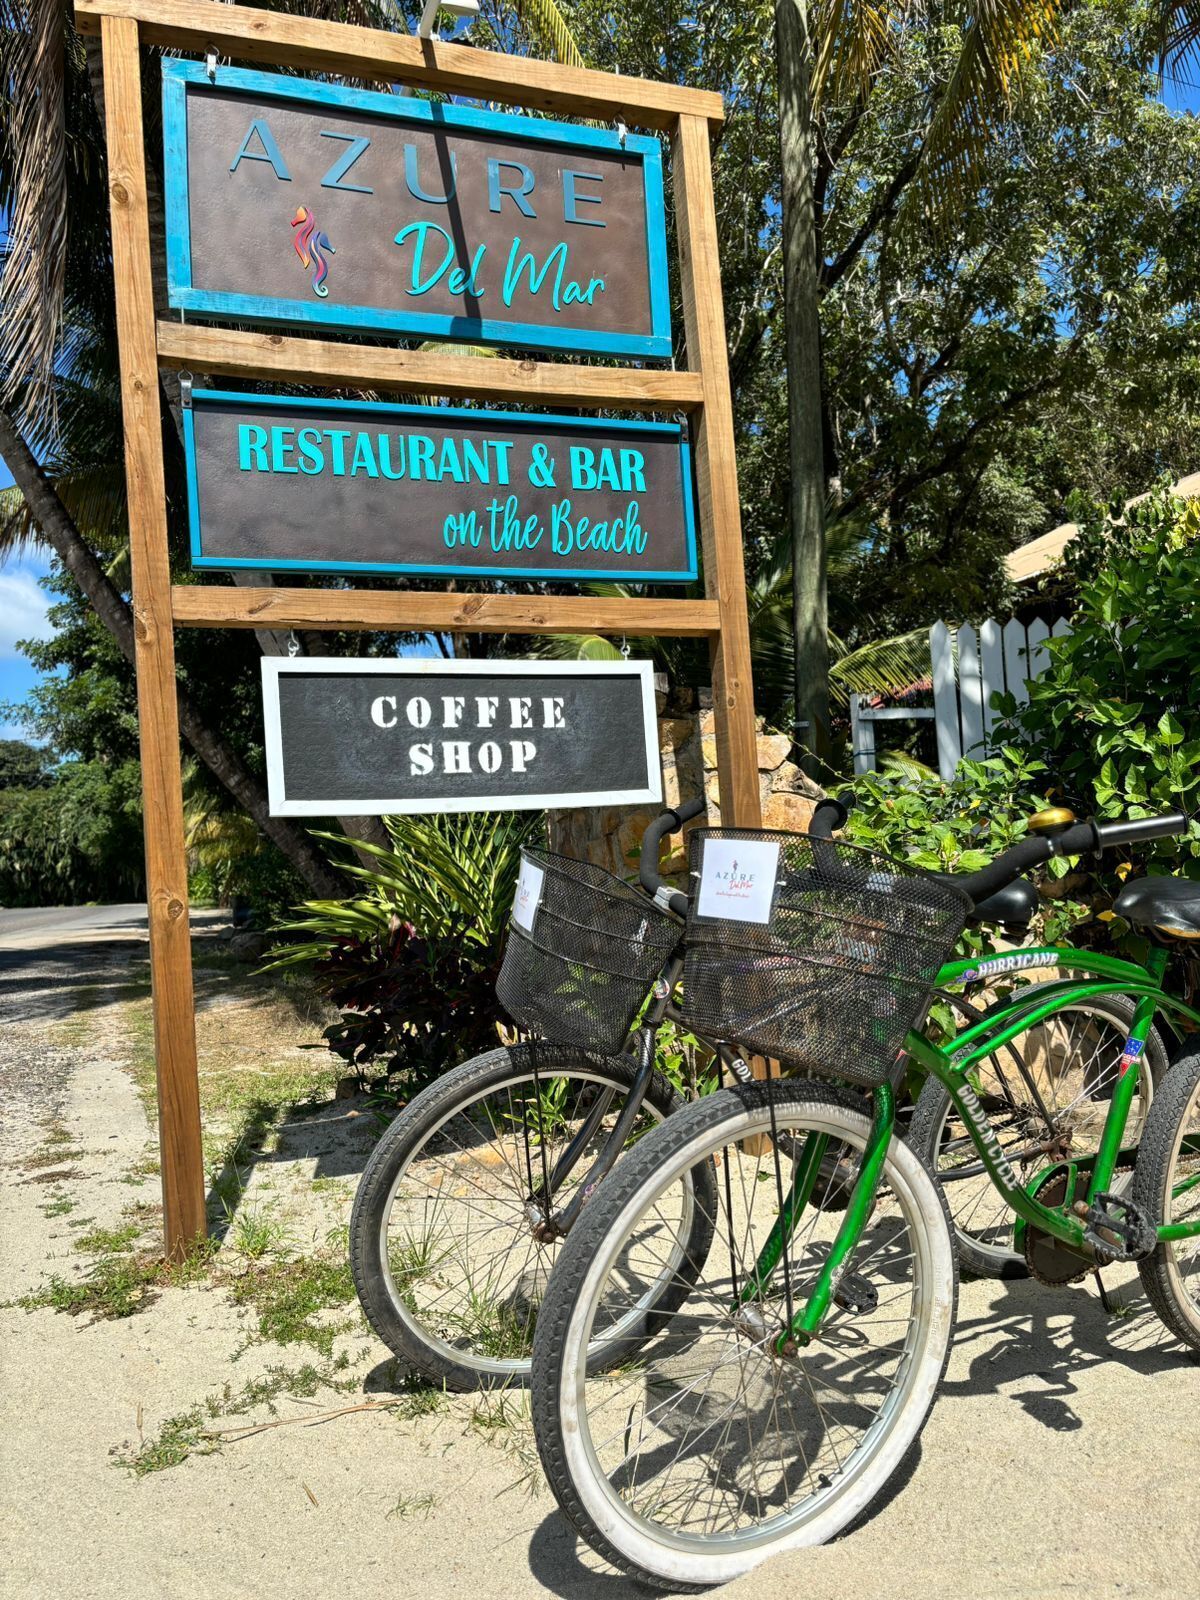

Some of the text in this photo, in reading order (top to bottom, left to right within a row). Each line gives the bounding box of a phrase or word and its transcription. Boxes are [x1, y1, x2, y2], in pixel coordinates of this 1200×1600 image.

[228, 118, 607, 228] AZURE
[394, 221, 607, 313] Del Mar
[237, 423, 647, 493] RESTAURANT & BAR
[442, 494, 648, 557] on the Beach
[370, 695, 567, 730] COFFEE
[408, 740, 538, 776] SHOP
[715, 871, 756, 882] AZURE
[731, 1058, 756, 1083] GOL
[957, 1084, 1018, 1192] GOLDEN CYCLE
